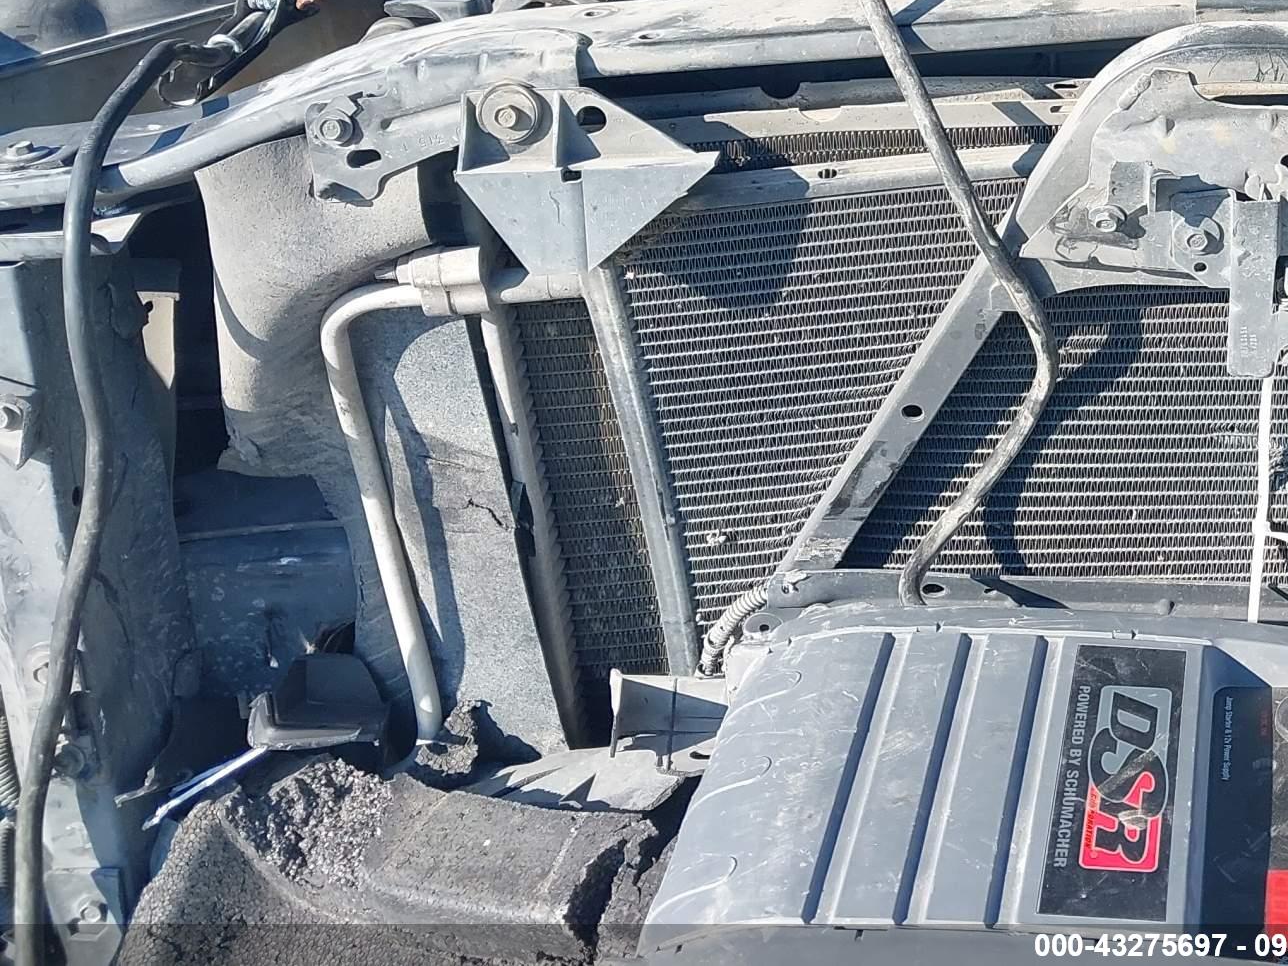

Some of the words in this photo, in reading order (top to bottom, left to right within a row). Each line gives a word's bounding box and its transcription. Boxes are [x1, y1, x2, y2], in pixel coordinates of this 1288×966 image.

[1070, 685, 1092, 746] POWERED
[1068, 747, 1083, 767] BY
[1088, 690, 1169, 865] DSR
[1222, 744, 1232, 761] Power
[1052, 768, 1080, 869] SCHUMACHER
